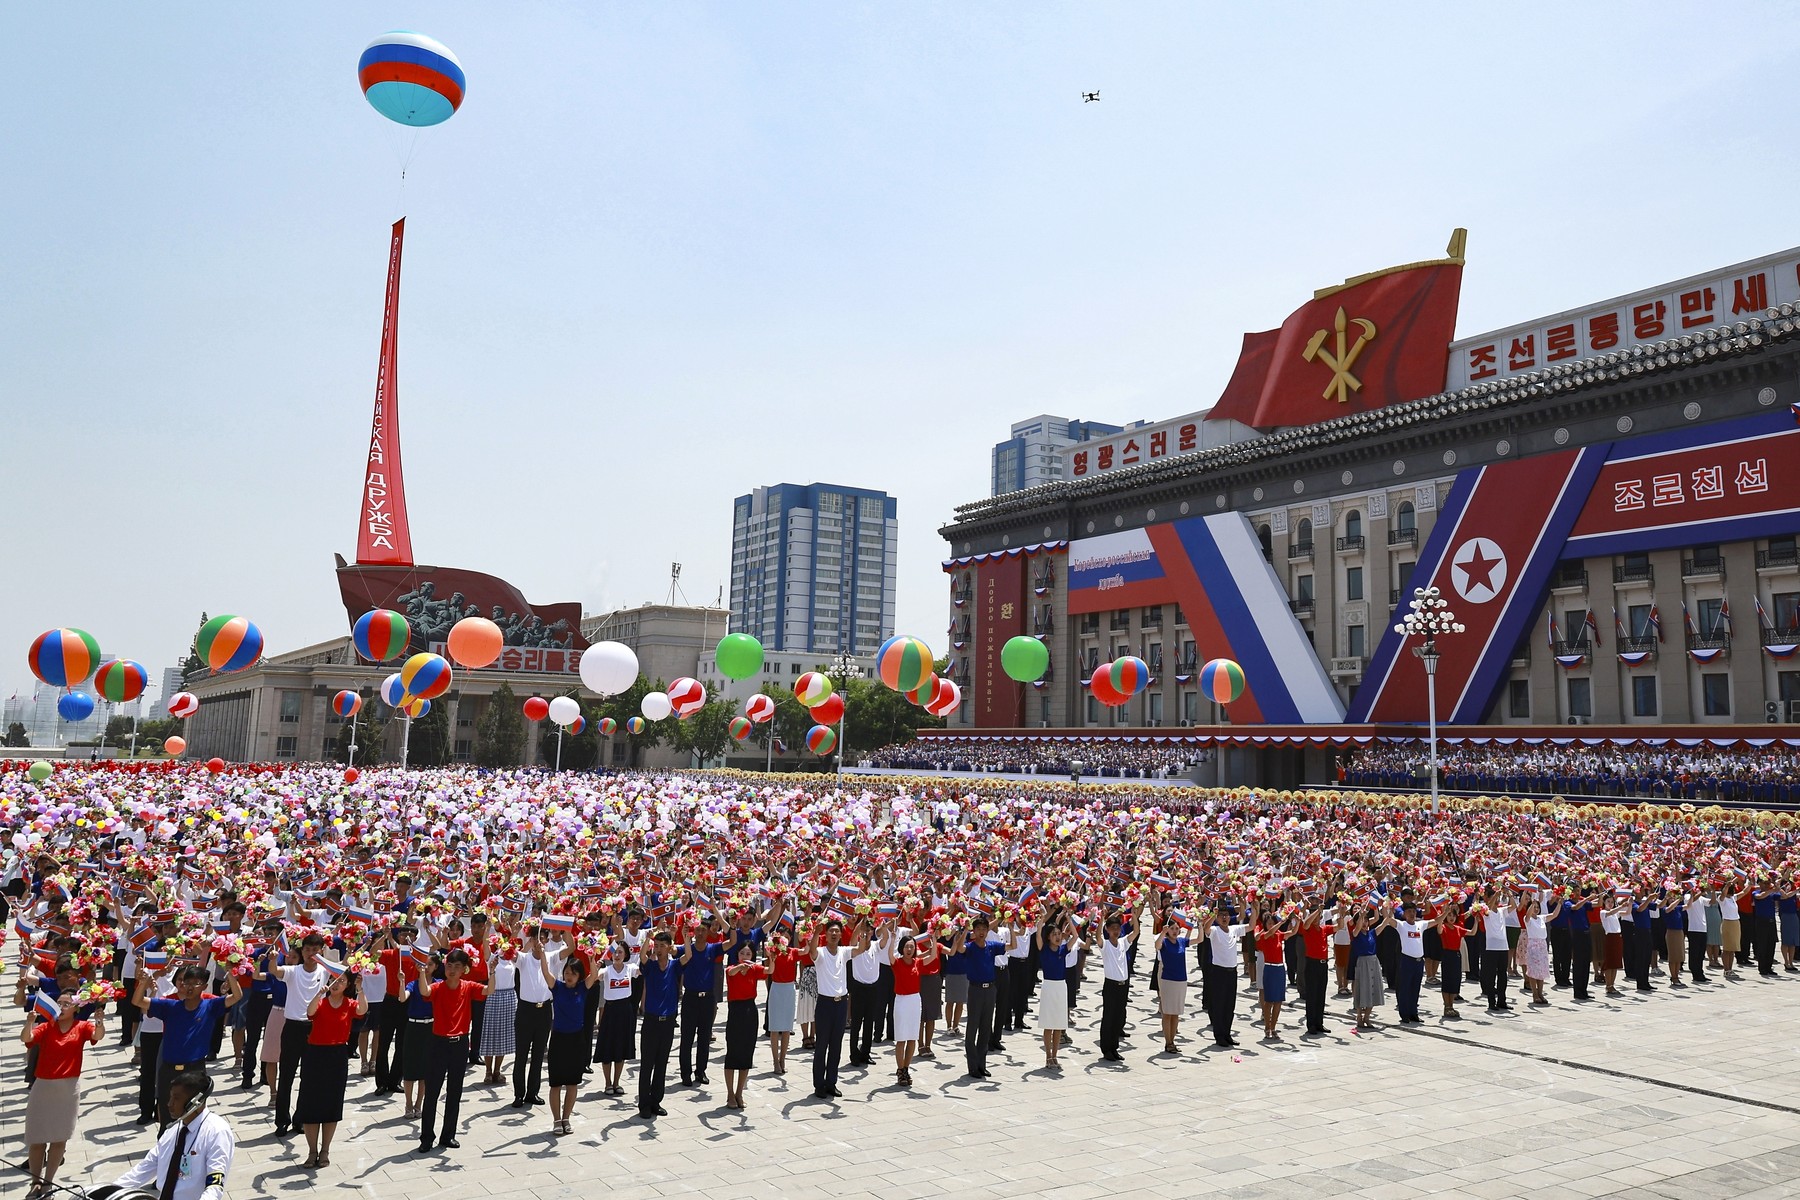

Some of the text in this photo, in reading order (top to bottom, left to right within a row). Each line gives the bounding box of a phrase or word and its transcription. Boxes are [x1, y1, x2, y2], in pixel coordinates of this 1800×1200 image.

[1073, 424, 1197, 476] 영광스러운
[367, 472, 393, 549] ДРУЖБА
[1615, 458, 1768, 512] 조로친선
